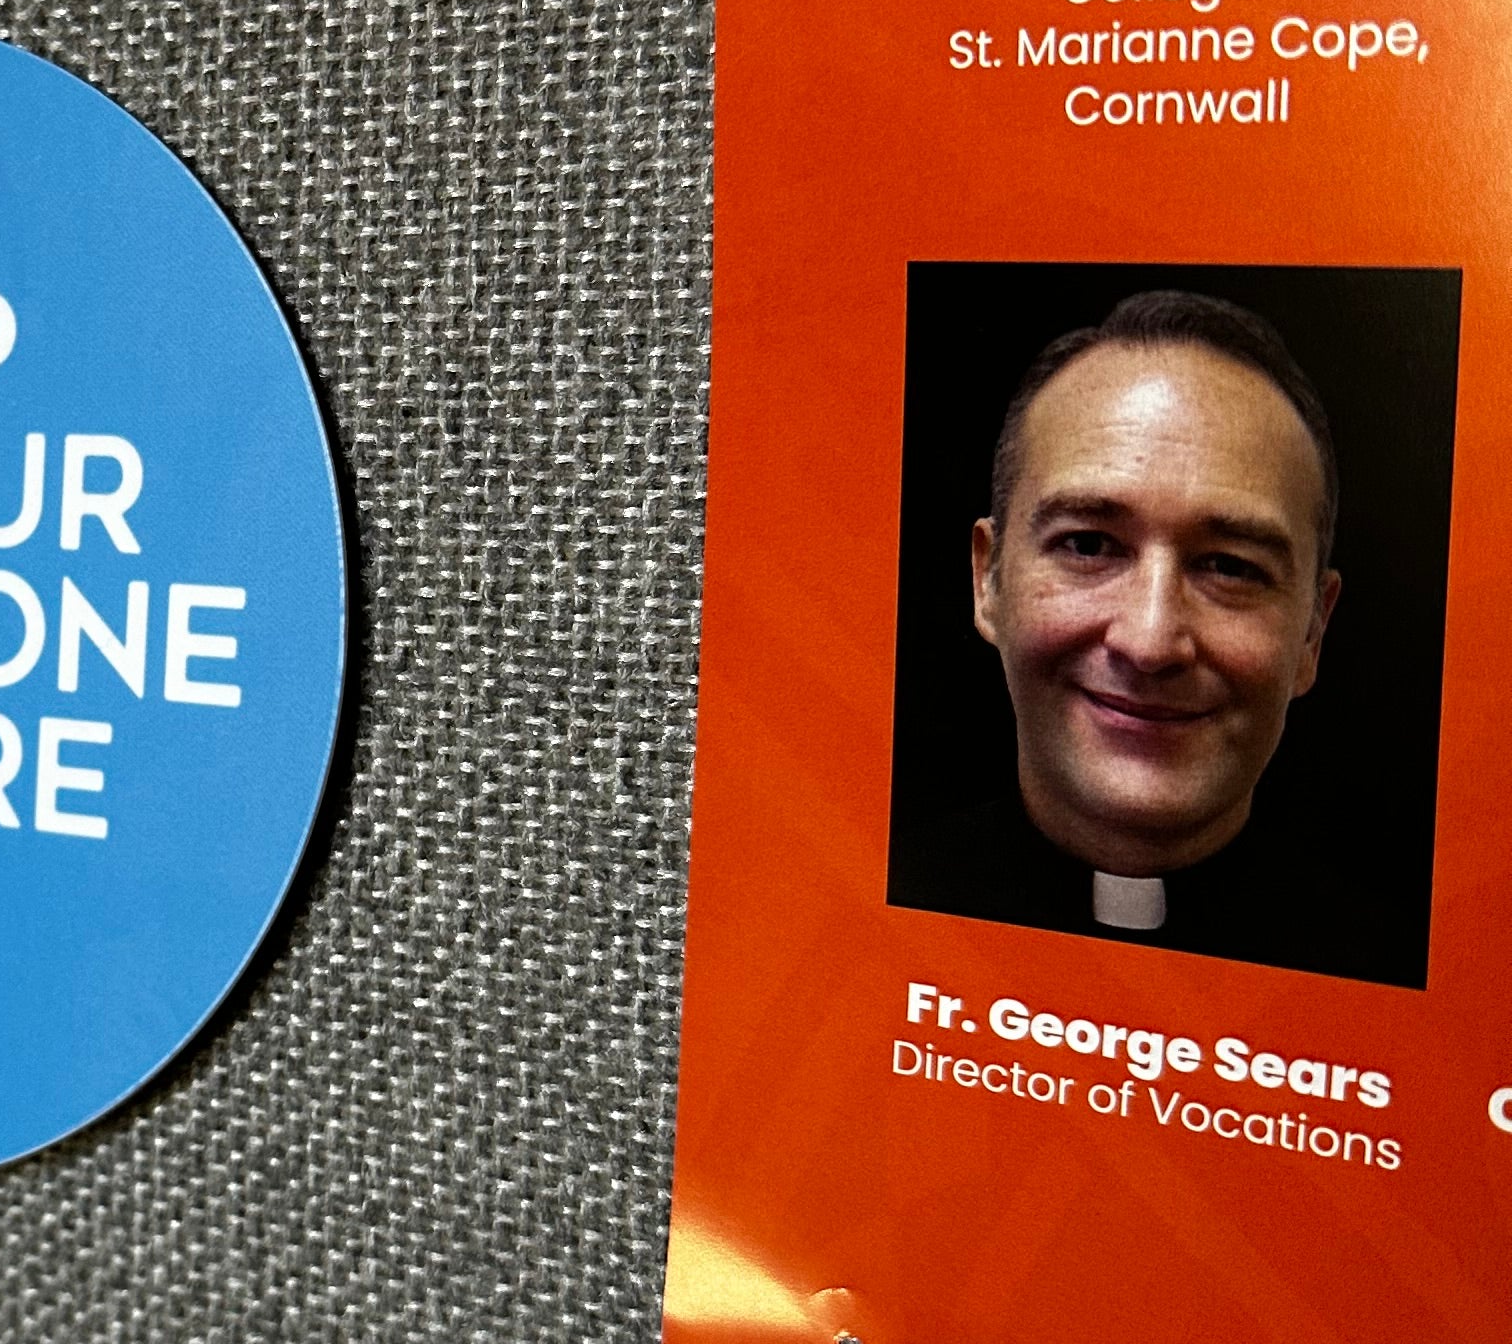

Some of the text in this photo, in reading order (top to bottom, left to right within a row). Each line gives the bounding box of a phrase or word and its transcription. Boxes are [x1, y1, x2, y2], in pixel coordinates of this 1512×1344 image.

[949, 16, 1430, 71] St. Marianne Cope,
[1064, 79, 1290, 125] Cornwall
[906, 981, 1392, 1109] Fr. George Sears
[892, 1039, 1402, 1172] Director of Vocations
